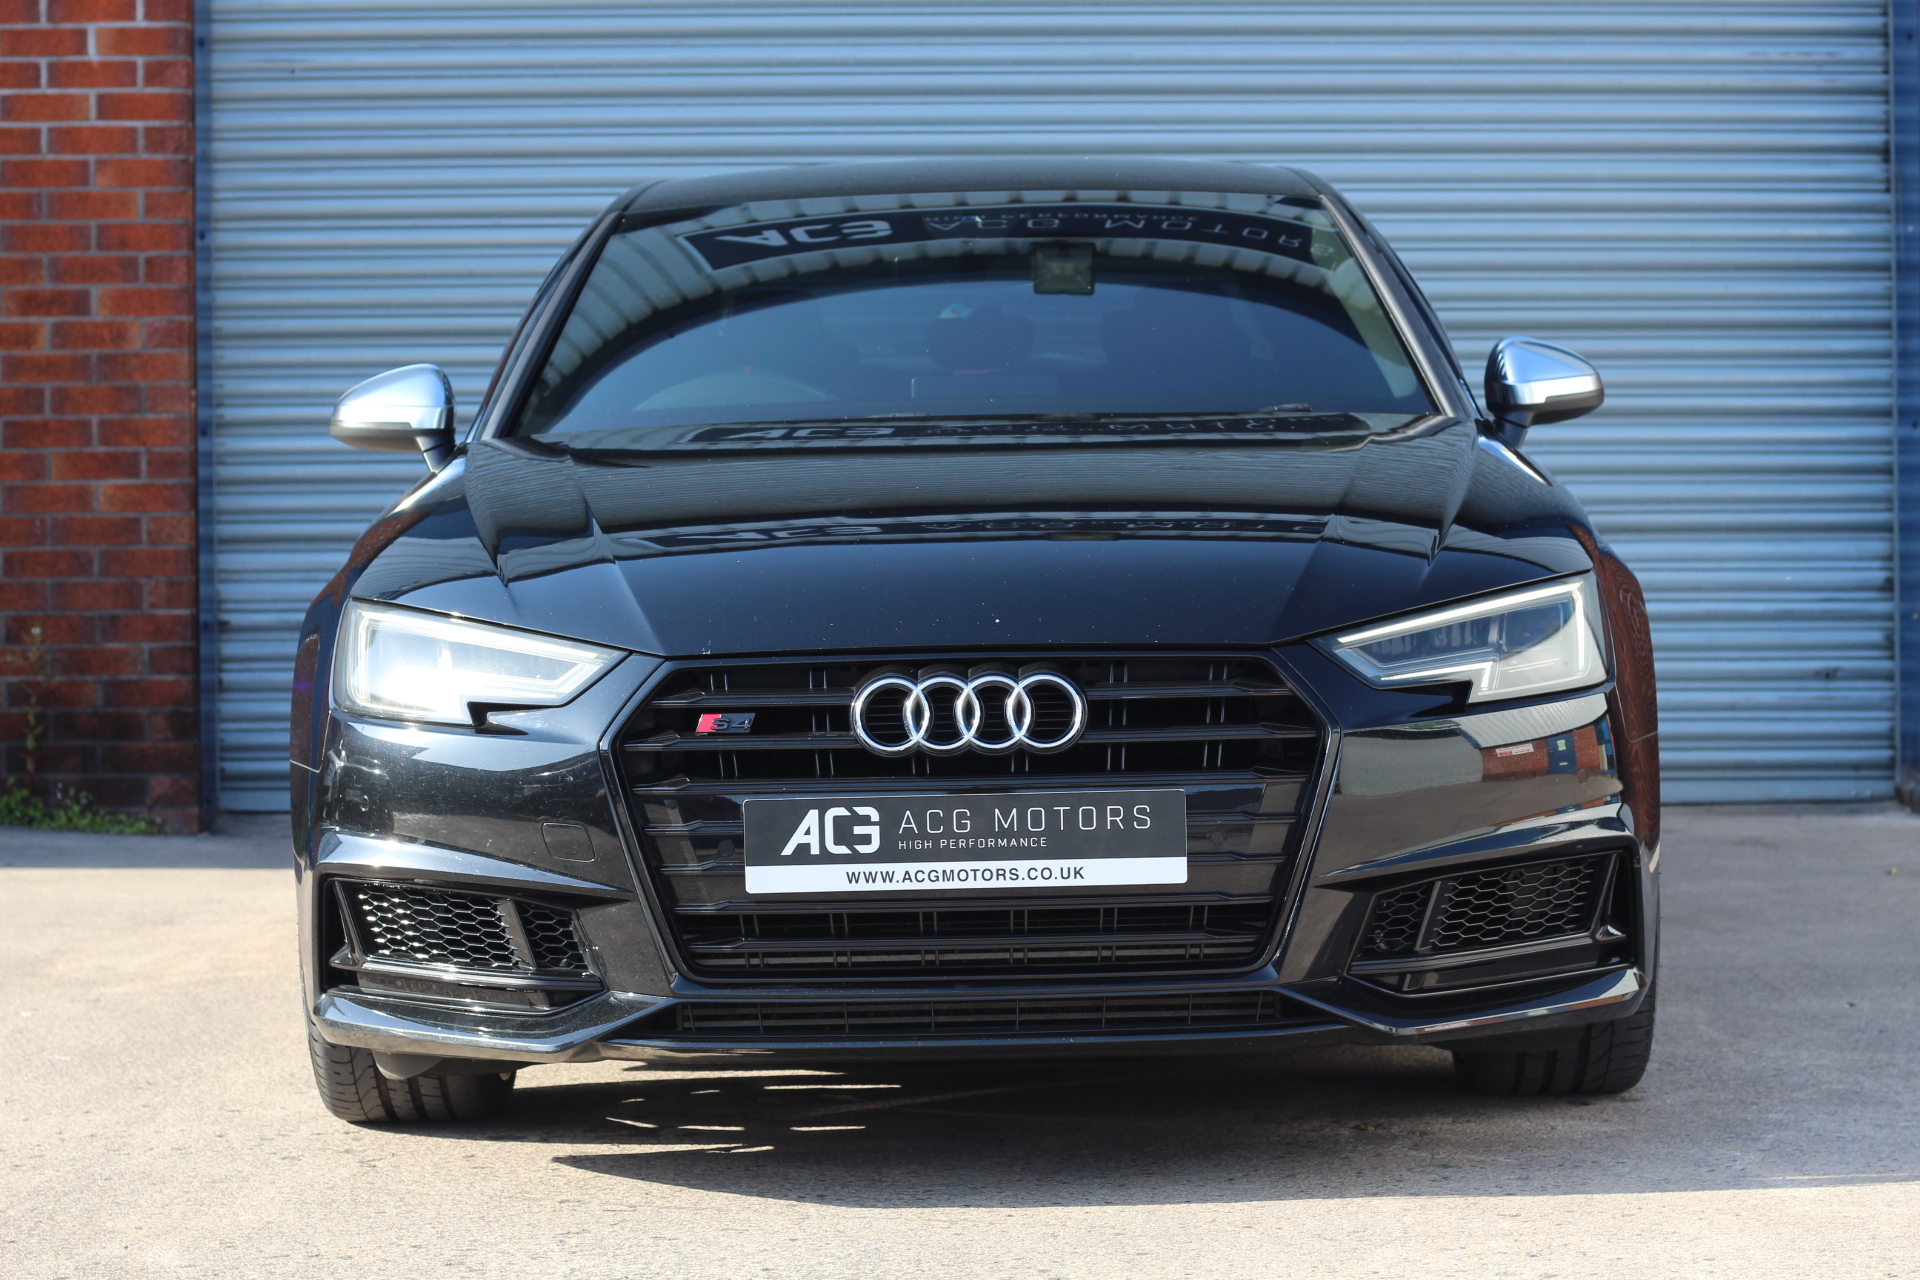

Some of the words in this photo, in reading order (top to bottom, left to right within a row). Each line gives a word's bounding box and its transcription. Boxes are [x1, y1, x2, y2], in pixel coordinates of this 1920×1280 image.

[710, 717, 752, 730] S4
[898, 808, 972, 834] ACG
[994, 804, 1153, 832] MOTORS
[780, 806, 881, 856] ACG
[898, 839, 932, 850] HIGH
[939, 836, 1048, 849] PERFORMANCE
[845, 865, 1086, 885] WWW.ACGMOTORS.CO.UK
